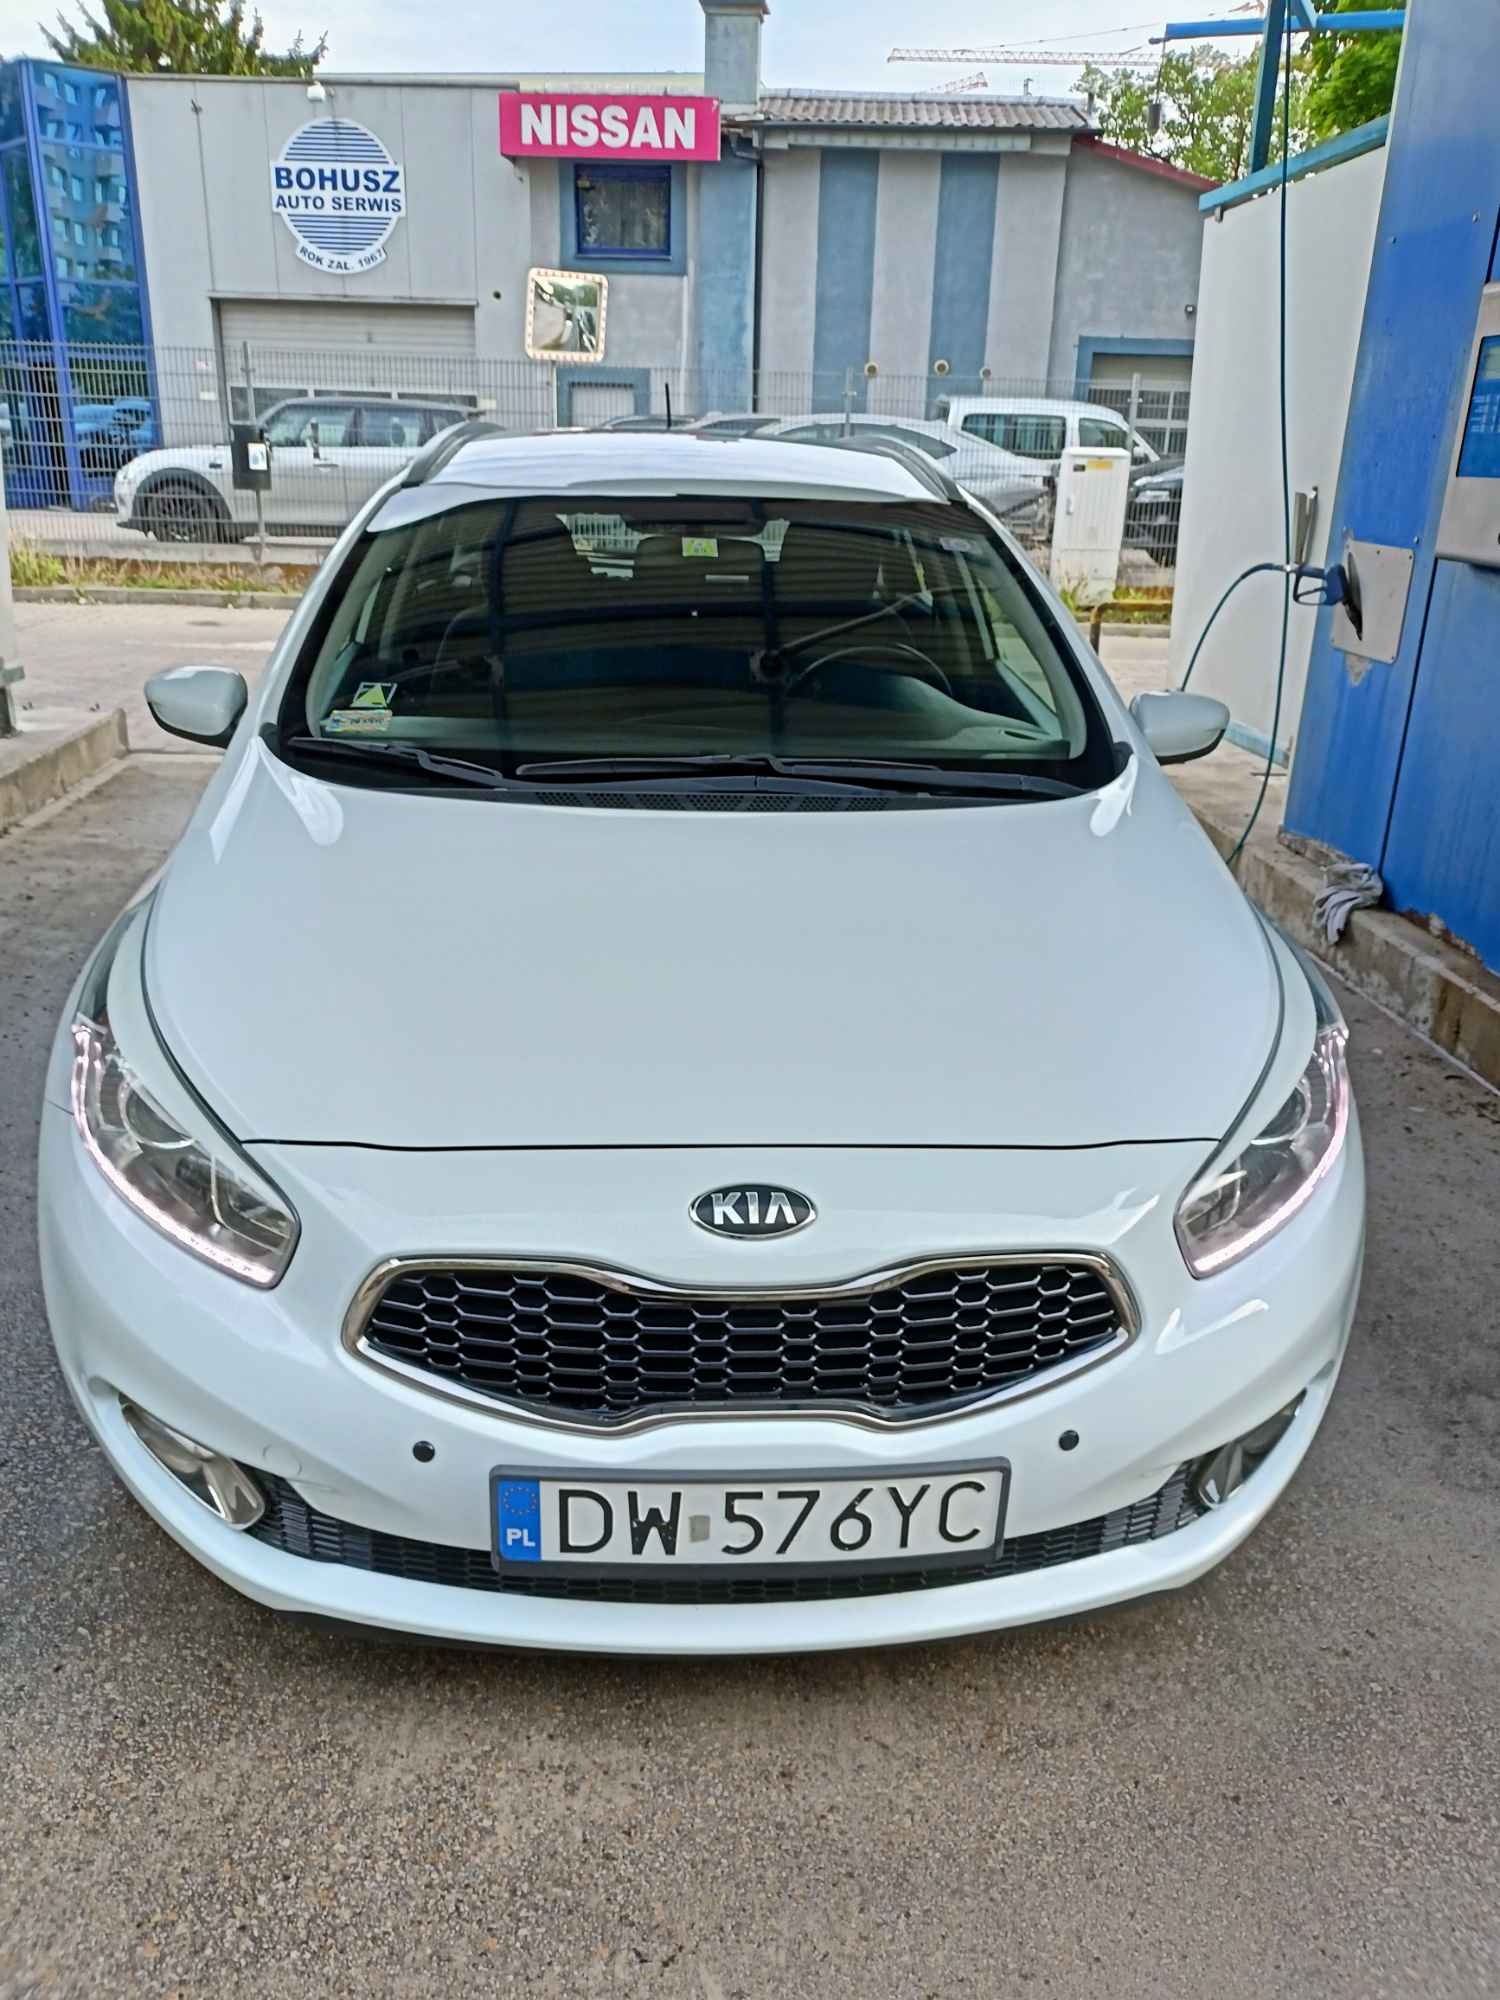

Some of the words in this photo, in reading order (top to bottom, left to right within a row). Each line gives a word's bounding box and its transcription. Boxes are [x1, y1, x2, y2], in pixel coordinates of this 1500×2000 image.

[520, 103, 696, 150] NISSAN
[274, 167, 401, 193] BOHUSZ
[275, 195, 325, 210] AUTO
[332, 196, 402, 213] SERWIS
[300, 246, 323, 266] ROK
[710, 1191, 798, 1225] KIA
[559, 1489, 682, 1555] DW
[722, 1481, 986, 1555] 576YC
[506, 1528, 536, 1547] PL
